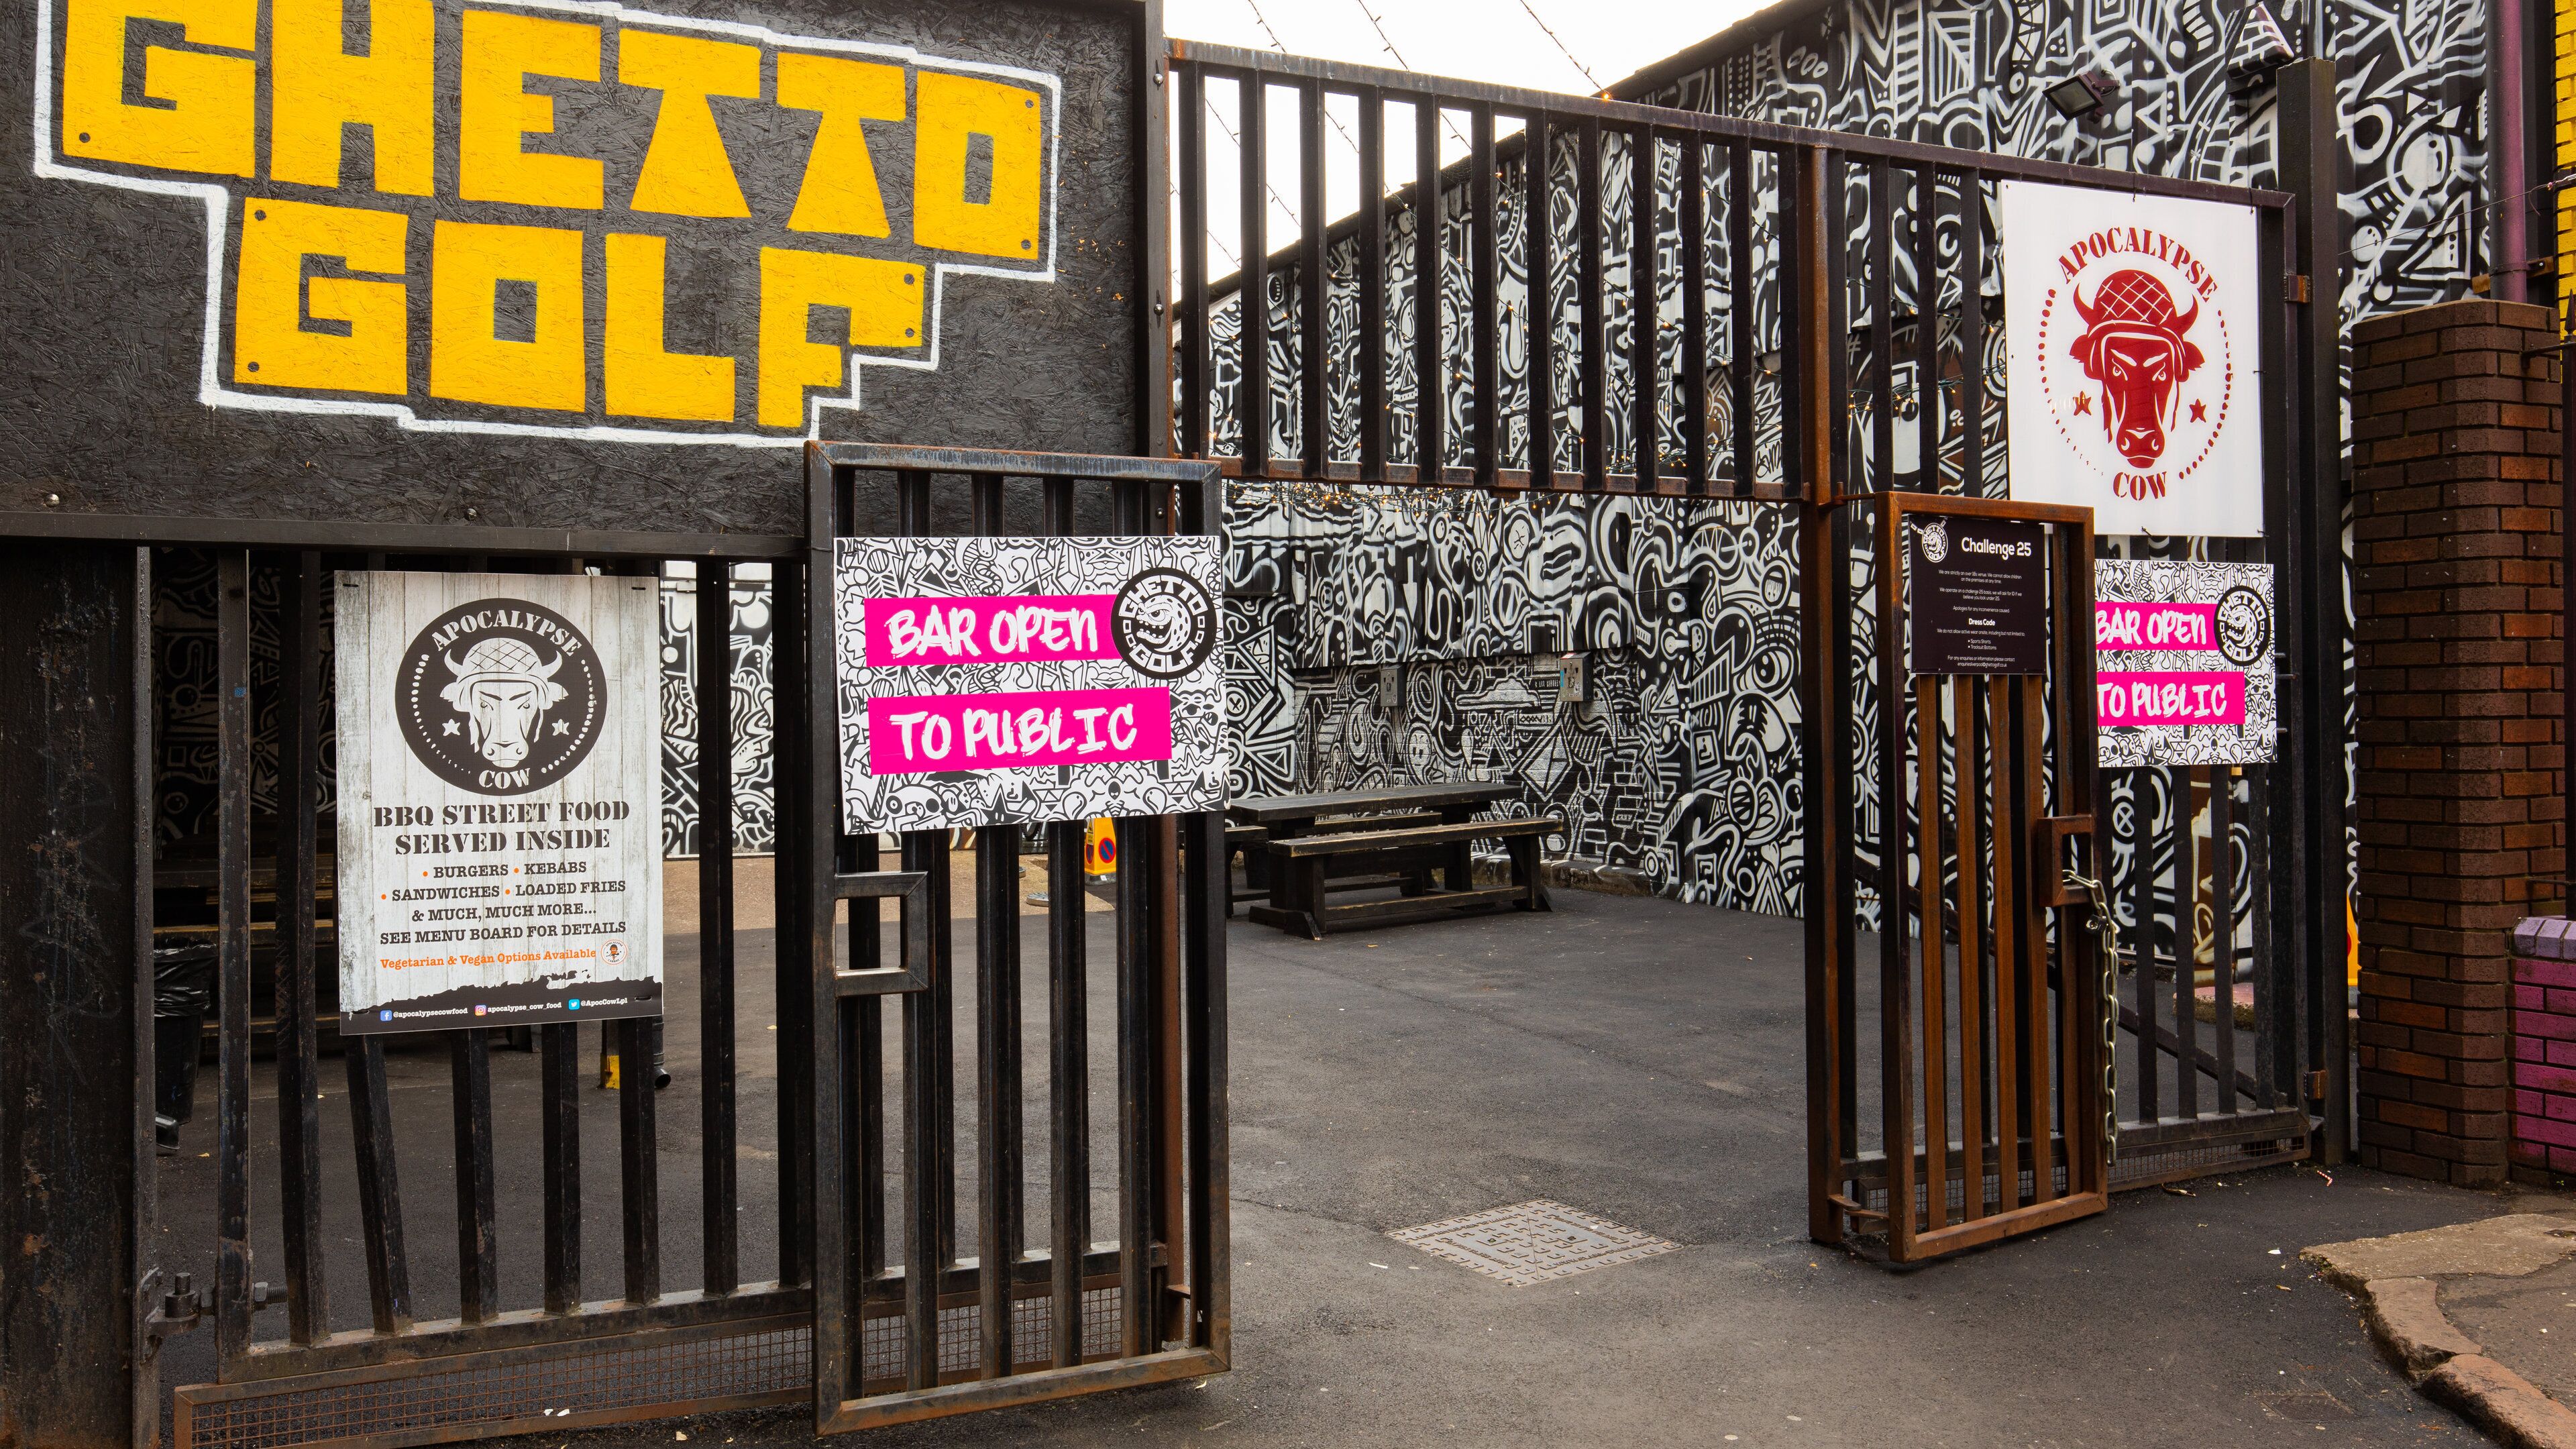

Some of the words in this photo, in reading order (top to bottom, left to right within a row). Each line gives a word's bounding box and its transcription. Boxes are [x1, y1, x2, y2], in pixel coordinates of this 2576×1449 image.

[62, 0, 1041, 260] GHETTO
[2058, 227, 2218, 303] APOCALYPSE
[234, 196, 924, 428] GOLF
[2112, 471, 2167, 500] COW
[1962, 537, 2015, 560] Challenge
[2017, 542, 2031, 556] 25
[1118, 575, 1208, 618] GHETTO
[2217, 590, 2267, 622] GHETTO
[431, 609, 582, 657] APOCALYPSE
[887, 604, 981, 659] BAR
[2096, 608, 2143, 645] BAR
[1129, 641, 1198, 673] GOLF
[2222, 639, 2260, 661] GOLF
[2098, 683, 2125, 718] TO
[2131, 682, 2226, 718] PUBLIC
[888, 706, 952, 761] TO
[962, 703, 1138, 757] PUBLIC
[478, 768, 531, 790] COW
[374, 806, 434, 827] BBQ
[442, 803, 551, 825] STREET
[559, 800, 630, 822] FOOD
[395, 832, 507, 855] SERVED
[515, 828, 610, 852] INSIDE
[433, 864, 508, 878] BURGERS
[524, 861, 587, 875] KEBABS
[392, 886, 500, 902] SANDWICHES
[516, 883, 576, 896] LOADED
[580, 881, 626, 894] FRIES
[411, 910, 424, 922] &
[428, 907, 482, 923] MUCH,
[485, 906, 534, 918] MUCH
[537, 903, 597, 916] MORE...
[380, 932, 411, 945] SEE
[415, 929, 466, 943] MENU
[470, 927, 523, 941] BOARD
[527, 926, 558, 938] FOR
[561, 922, 627, 936] DETAILS
[380, 956, 445, 970] Vegetarian
[447, 955, 458, 965] &
[460, 953, 494, 968] Vegan
[497, 951, 541, 965] Options
[543, 948, 596, 961] Available
[393, 1008, 468, 1018] @apocalypsecowfood
[487, 1002, 562, 1014] apocalypse_cow_food
